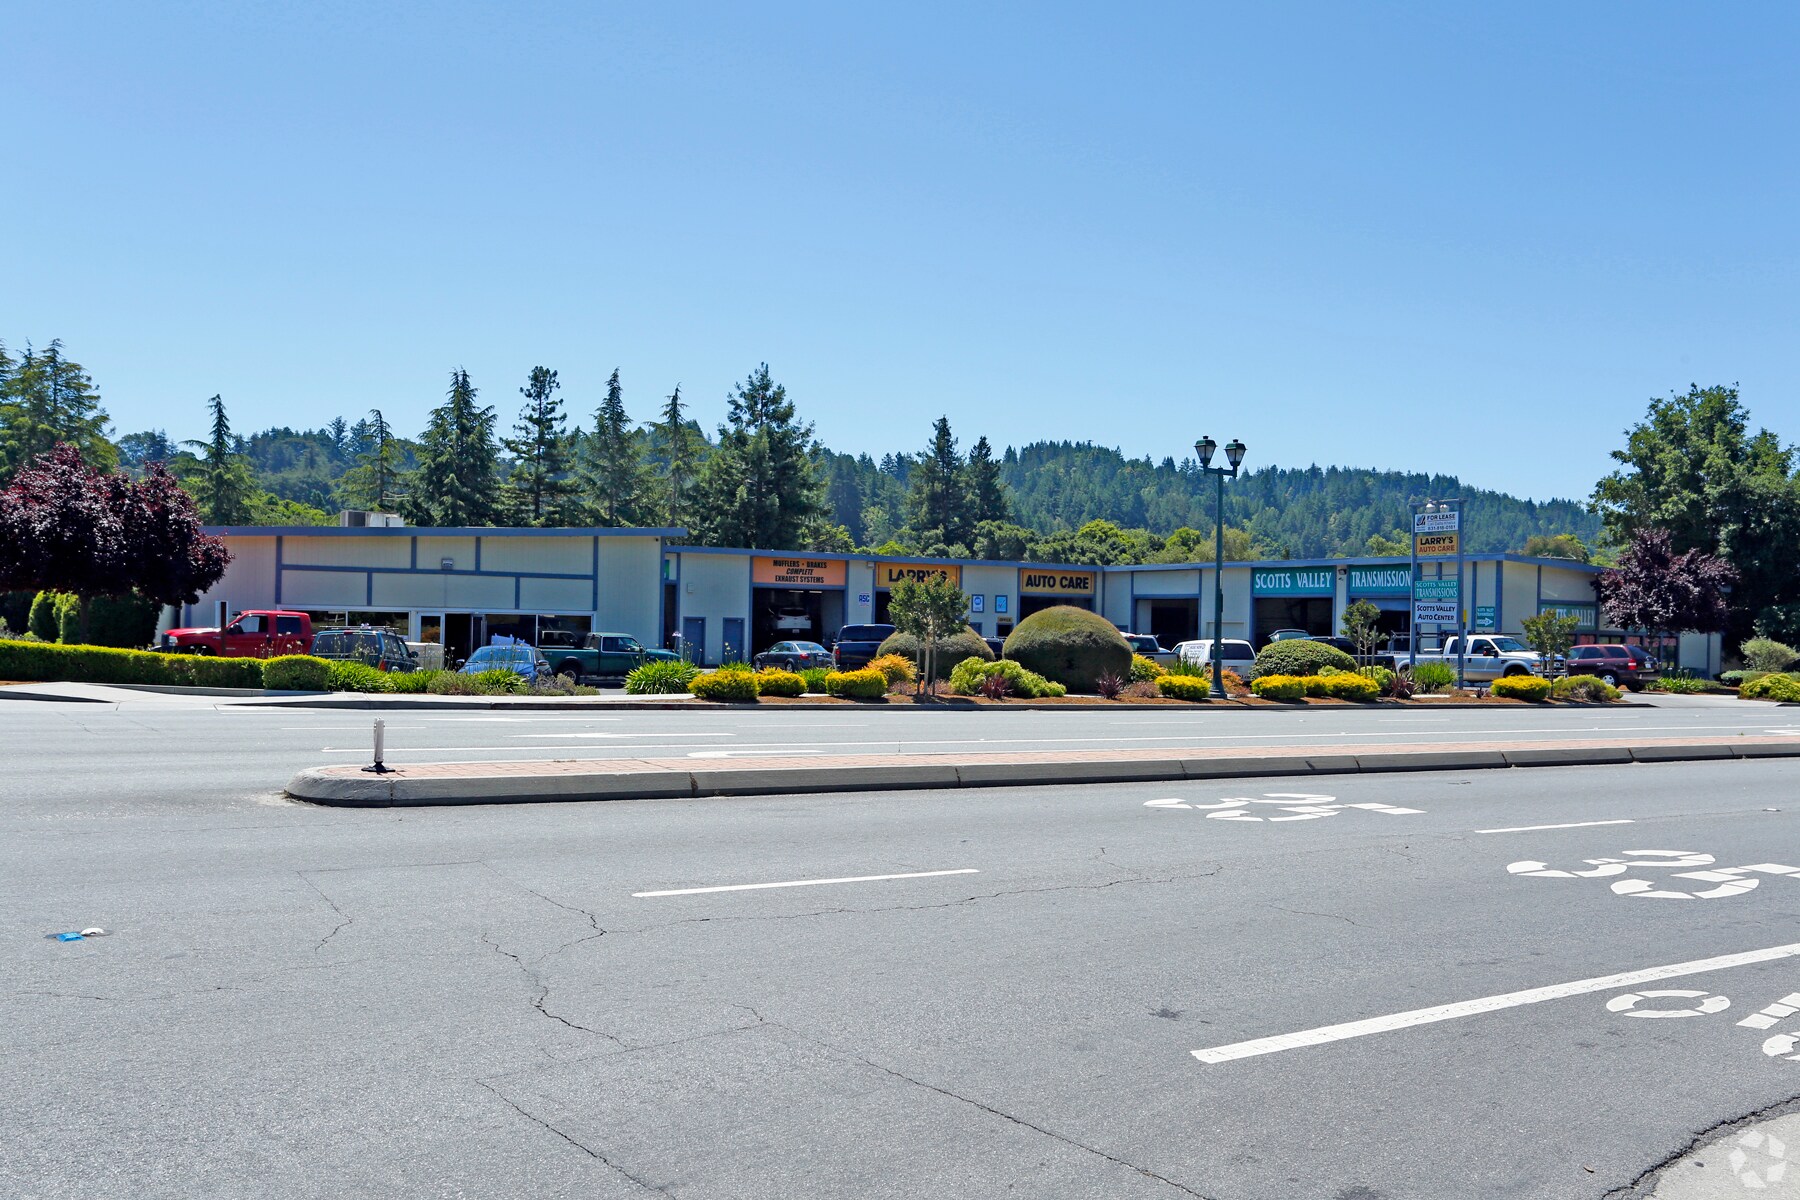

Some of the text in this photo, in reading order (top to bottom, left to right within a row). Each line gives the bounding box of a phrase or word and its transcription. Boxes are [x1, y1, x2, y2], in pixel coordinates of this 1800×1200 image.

[1420, 536, 1454, 546] LARRY'S
[773, 560, 800, 568] MUFFLERS
[786, 568, 814, 576] COMPLETE
[775, 575, 825, 584] EXHAUST SYSTEMS
[1025, 574, 1090, 590] AUTO CARE
[1255, 572, 1332, 589] SCOTTS VALLEY
[1416, 587, 1458, 598] TRANSMISSIONS
[1436, 604, 1456, 612] VALLEY
[1417, 613, 1455, 621] AUTO CENTER
